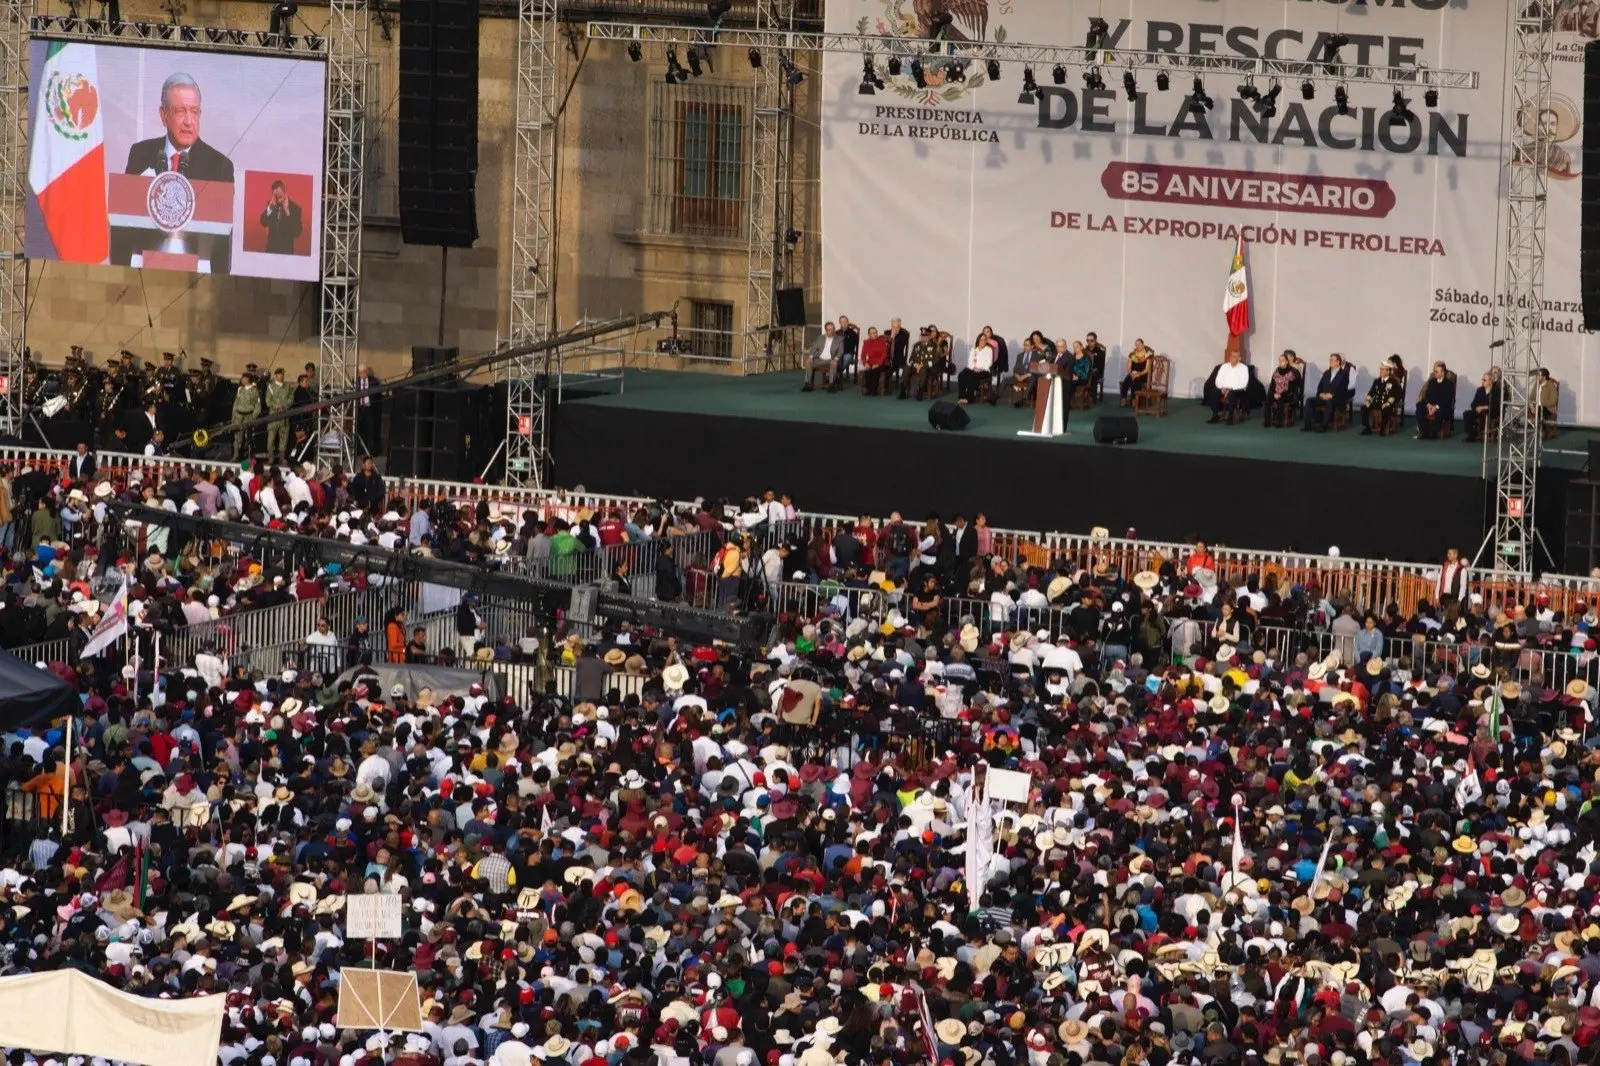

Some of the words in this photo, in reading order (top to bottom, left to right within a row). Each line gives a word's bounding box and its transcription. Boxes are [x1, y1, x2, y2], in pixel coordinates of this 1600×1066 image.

[1145, 20, 1424, 82] RESCATE
[875, 105, 984, 124] PRESIDENCIA
[1037, 85, 1117, 134] DE
[1133, 87, 1215, 141] LA
[1229, 97, 1470, 158] NACIÓN
[858, 121, 881, 137] DE
[883, 123, 904, 138] LA
[907, 123, 1000, 144] REPÚBLICA
[1120, 170, 1159, 197] 85
[1164, 174, 1376, 211] ANIVERSARIO
[1050, 211, 1081, 231] DE
[1086, 213, 1118, 233] LA
[1123, 217, 1298, 246] EXPROPIACIÓN
[1303, 230, 1446, 257] PETROLERA
[1434, 287, 1493, 308] Sábado,
[1429, 308, 1479, 327] Zócalo
[1481, 311, 1500, 328] de
